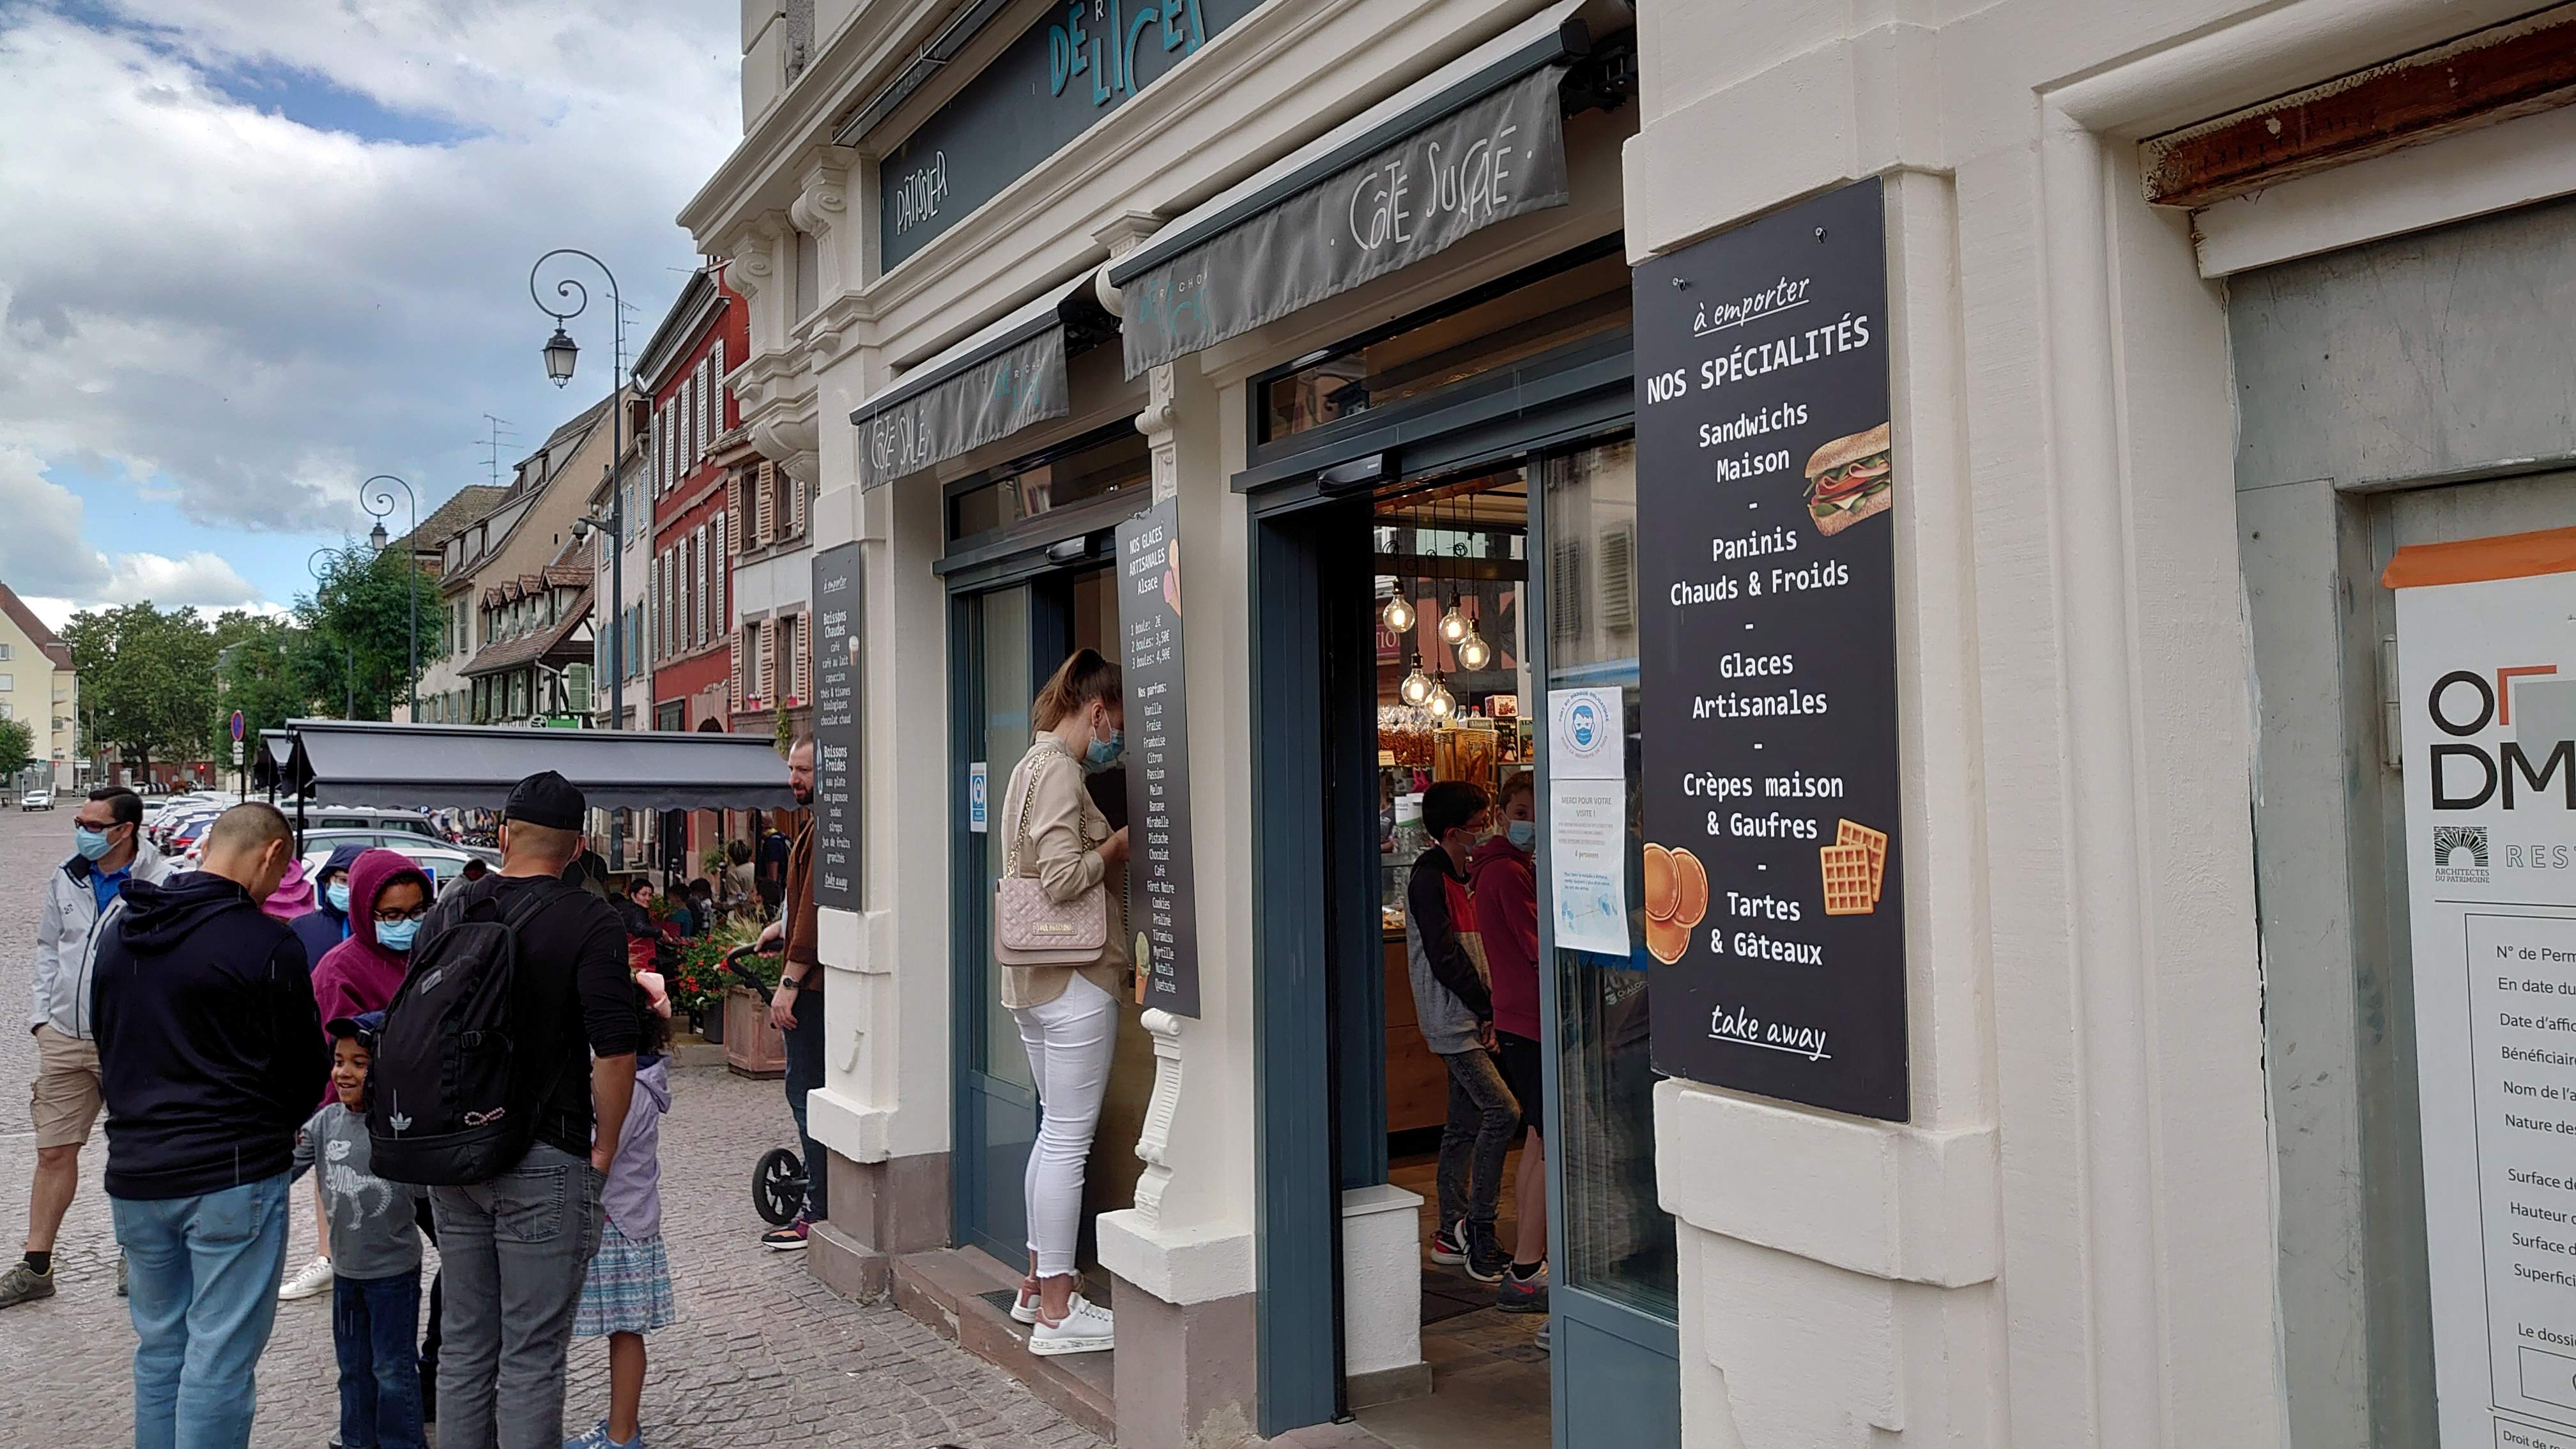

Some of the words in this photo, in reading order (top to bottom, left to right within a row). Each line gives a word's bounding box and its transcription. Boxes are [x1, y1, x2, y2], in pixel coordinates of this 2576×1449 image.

[897, 151, 947, 235] PÂTISSIER
[1350, 160, 1411, 250] CÔTÉ
[1693, 302, 1706, 332] à
[1714, 277, 1809, 326] emporter
[1647, 369, 1687, 404] NOS
[1700, 312, 1871, 390] SPÉCIALITÉS
[1699, 402, 1809, 447] Sandwichs
[1716, 448, 1790, 482] Maison
[1129, 537, 1140, 555] NOS
[1142, 525, 1163, 548] GLACES
[1712, 528, 1798, 562] Paninis
[1129, 548, 1165, 577] ARTISANALES
[1138, 576, 1158, 595] Alsace
[1670, 576, 1738, 606] Chauds
[1749, 572, 1762, 597] &
[1772, 560, 1850, 594] Froids
[824, 610, 847, 625] Boissons
[825, 625, 845, 638] Chaudes
[1720, 652, 1794, 678] Glaces
[1692, 689, 1828, 719] Artisanales
[824, 744, 848, 758] Boissons
[825, 758, 847, 772] Froides
[1765, 771, 1843, 798] maison
[1707, 811, 1719, 835] &
[1730, 811, 1818, 839] Gaufres
[2506, 845, 2576, 869] RES
[1727, 892, 1800, 922] Tartes
[1710, 929, 1724, 953] &
[1734, 931, 1823, 965] Gâteaux
[2497, 946, 2513, 958] N°
[2518, 947, 2536, 960] de
[2499, 977, 2517, 990] En
[2522, 979, 2554, 993] date
[2558, 982, 2576, 995] du
[2500, 1013, 2532, 1028] Date
[1712, 1006, 1759, 1041] take
[1767, 1025, 1827, 1061] away
[2502, 1046, 2576, 1065] Bénéficiair
[2504, 1080, 2536, 1096] Nom
[2541, 1085, 2558, 1099] de
[2505, 1114, 2552, 1131] Nature
[2508, 1169, 2561, 1188] Surface
[2510, 1202, 2568, 1223] Hauteur
[2512, 1232, 2564, 1254] Surface
[2518, 1322, 2534, 1338] Le
[2538, 1328, 2576, 1347] dossi
[2503, 1430, 2530, 1446] Droit
[2533, 1439, 2546, 1449] de
